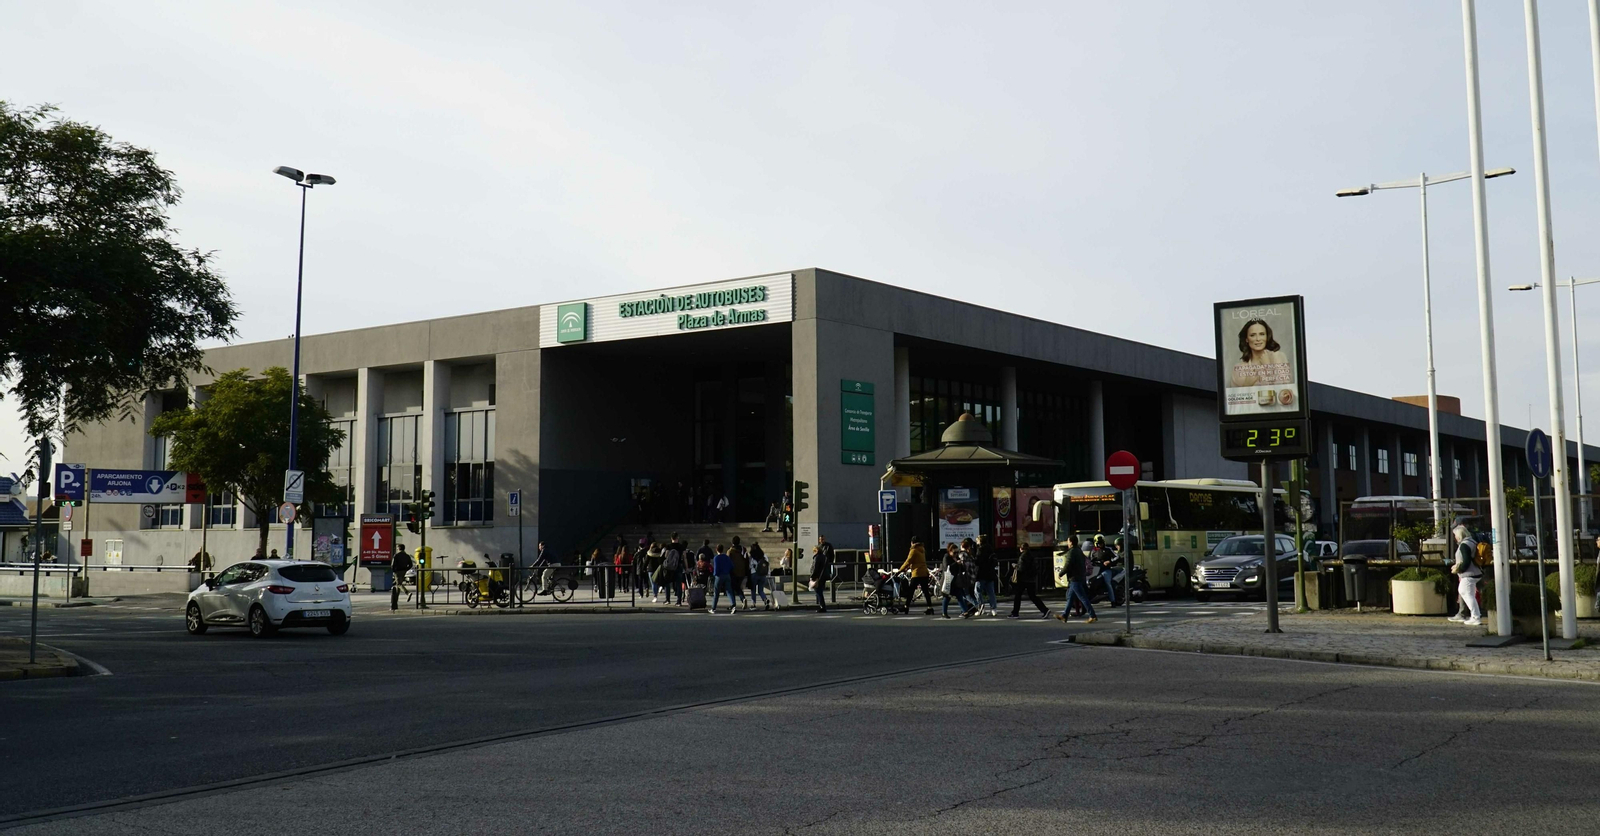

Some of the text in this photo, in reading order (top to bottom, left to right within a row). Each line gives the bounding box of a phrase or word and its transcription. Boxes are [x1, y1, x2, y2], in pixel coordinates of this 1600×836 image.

[619, 285, 766, 318] ESTACIÓN DE AUTOBUSES
[677, 308, 765, 329] Plaza de Armas
[60, 470, 75, 489] P
